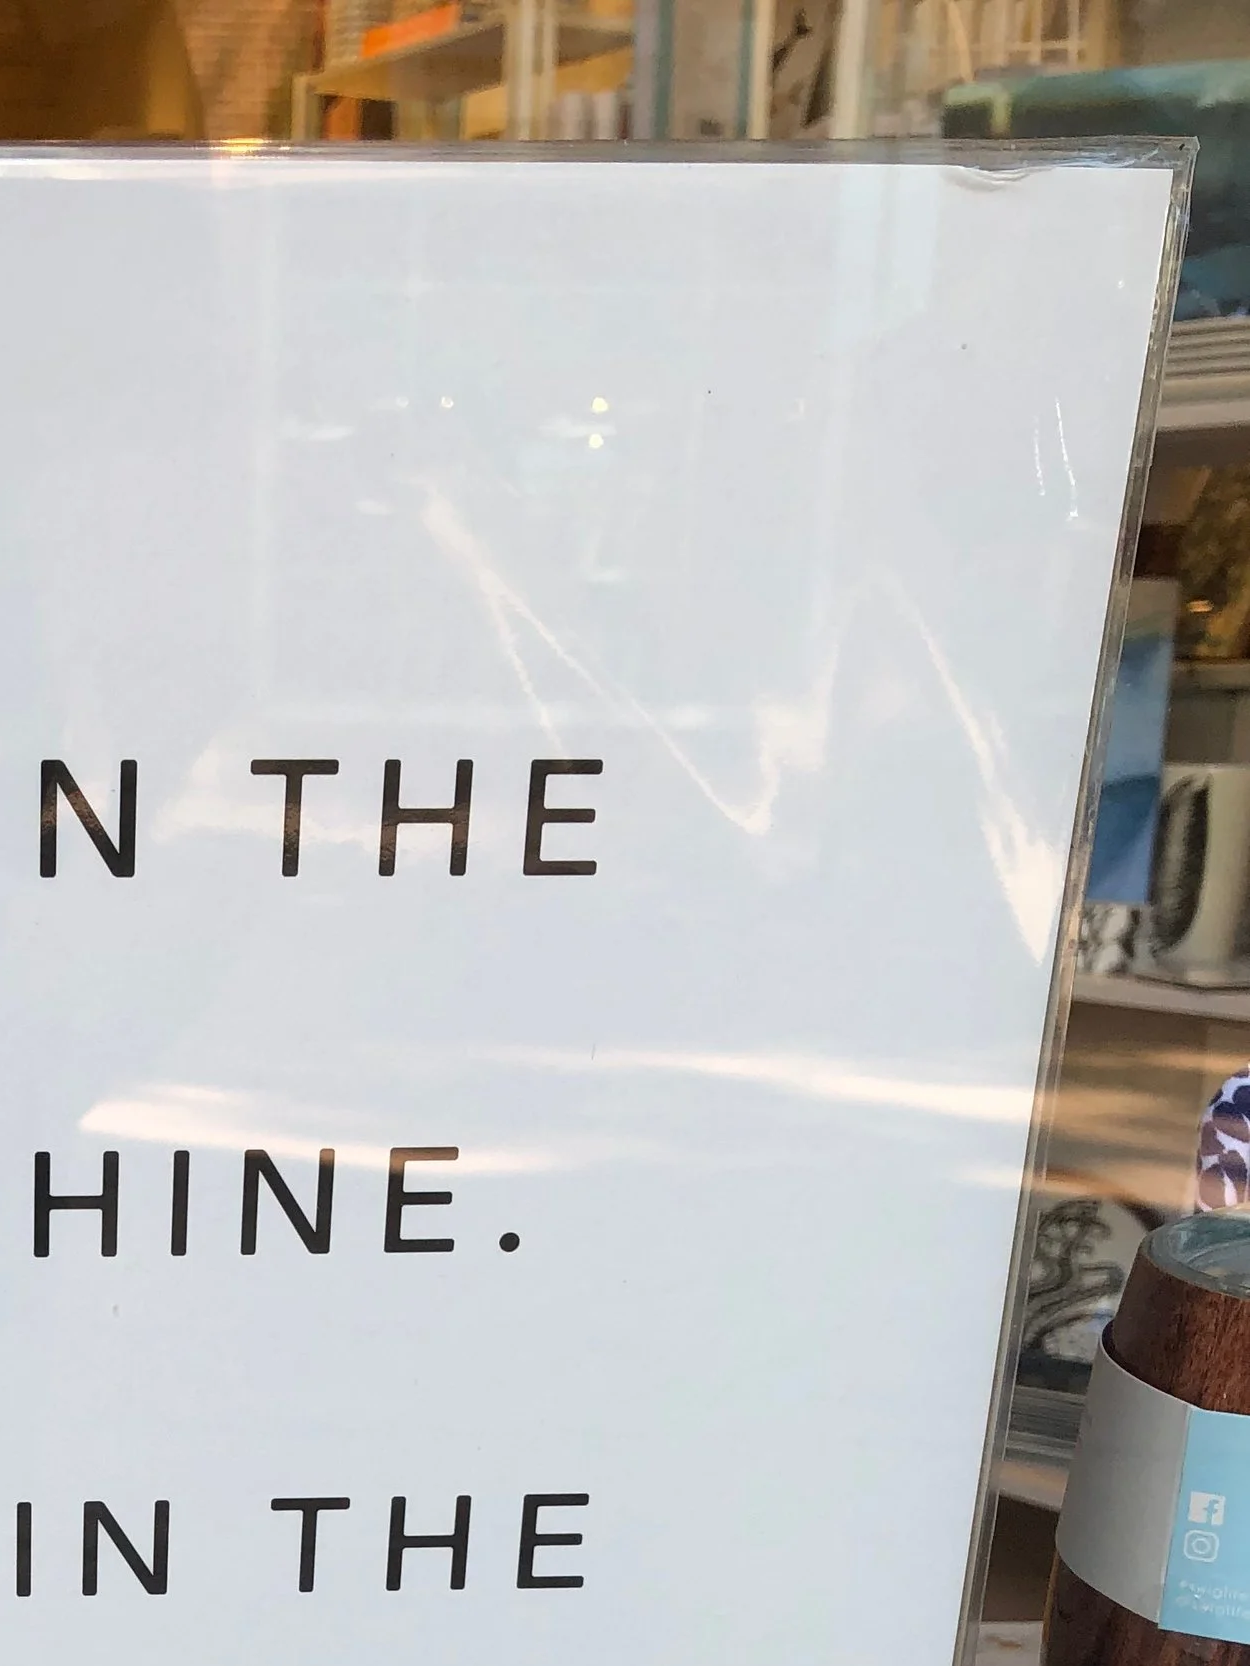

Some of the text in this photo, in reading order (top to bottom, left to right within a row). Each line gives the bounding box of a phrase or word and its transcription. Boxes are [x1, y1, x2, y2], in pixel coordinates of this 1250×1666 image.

[249, 758, 604, 879] THE
[15, 1499, 171, 1598] IN
[270, 1492, 590, 1593] THE
